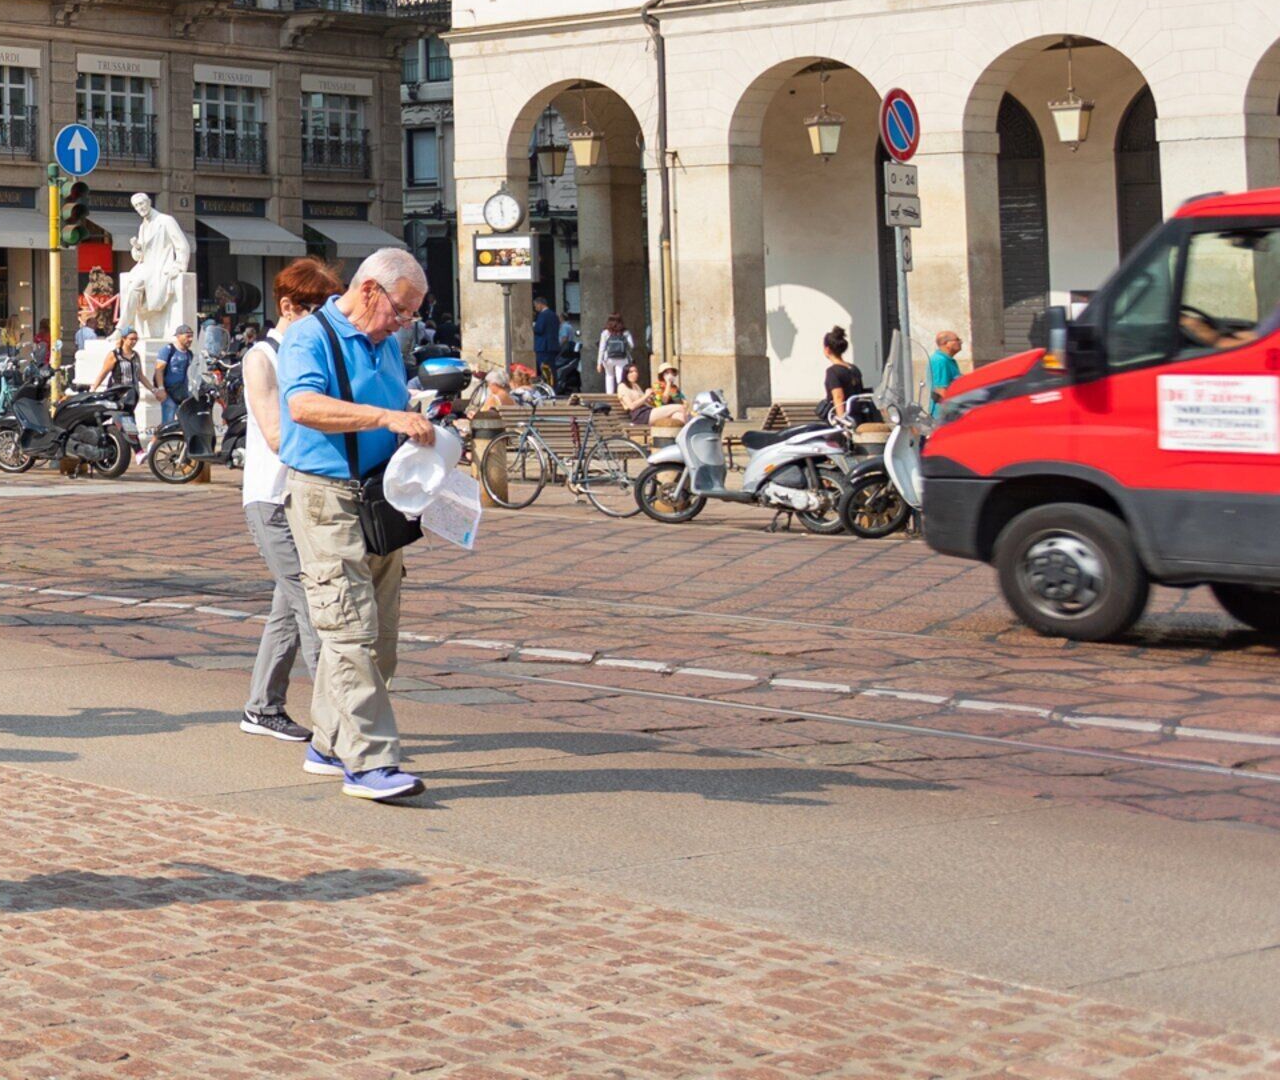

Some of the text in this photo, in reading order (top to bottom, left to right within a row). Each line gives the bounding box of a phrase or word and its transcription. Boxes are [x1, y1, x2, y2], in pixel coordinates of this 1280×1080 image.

[97, 59, 140, 73] TRUSSARDI
[213, 70, 253, 84] TRUSSARDI
[890, 172, 896, 184] 0
